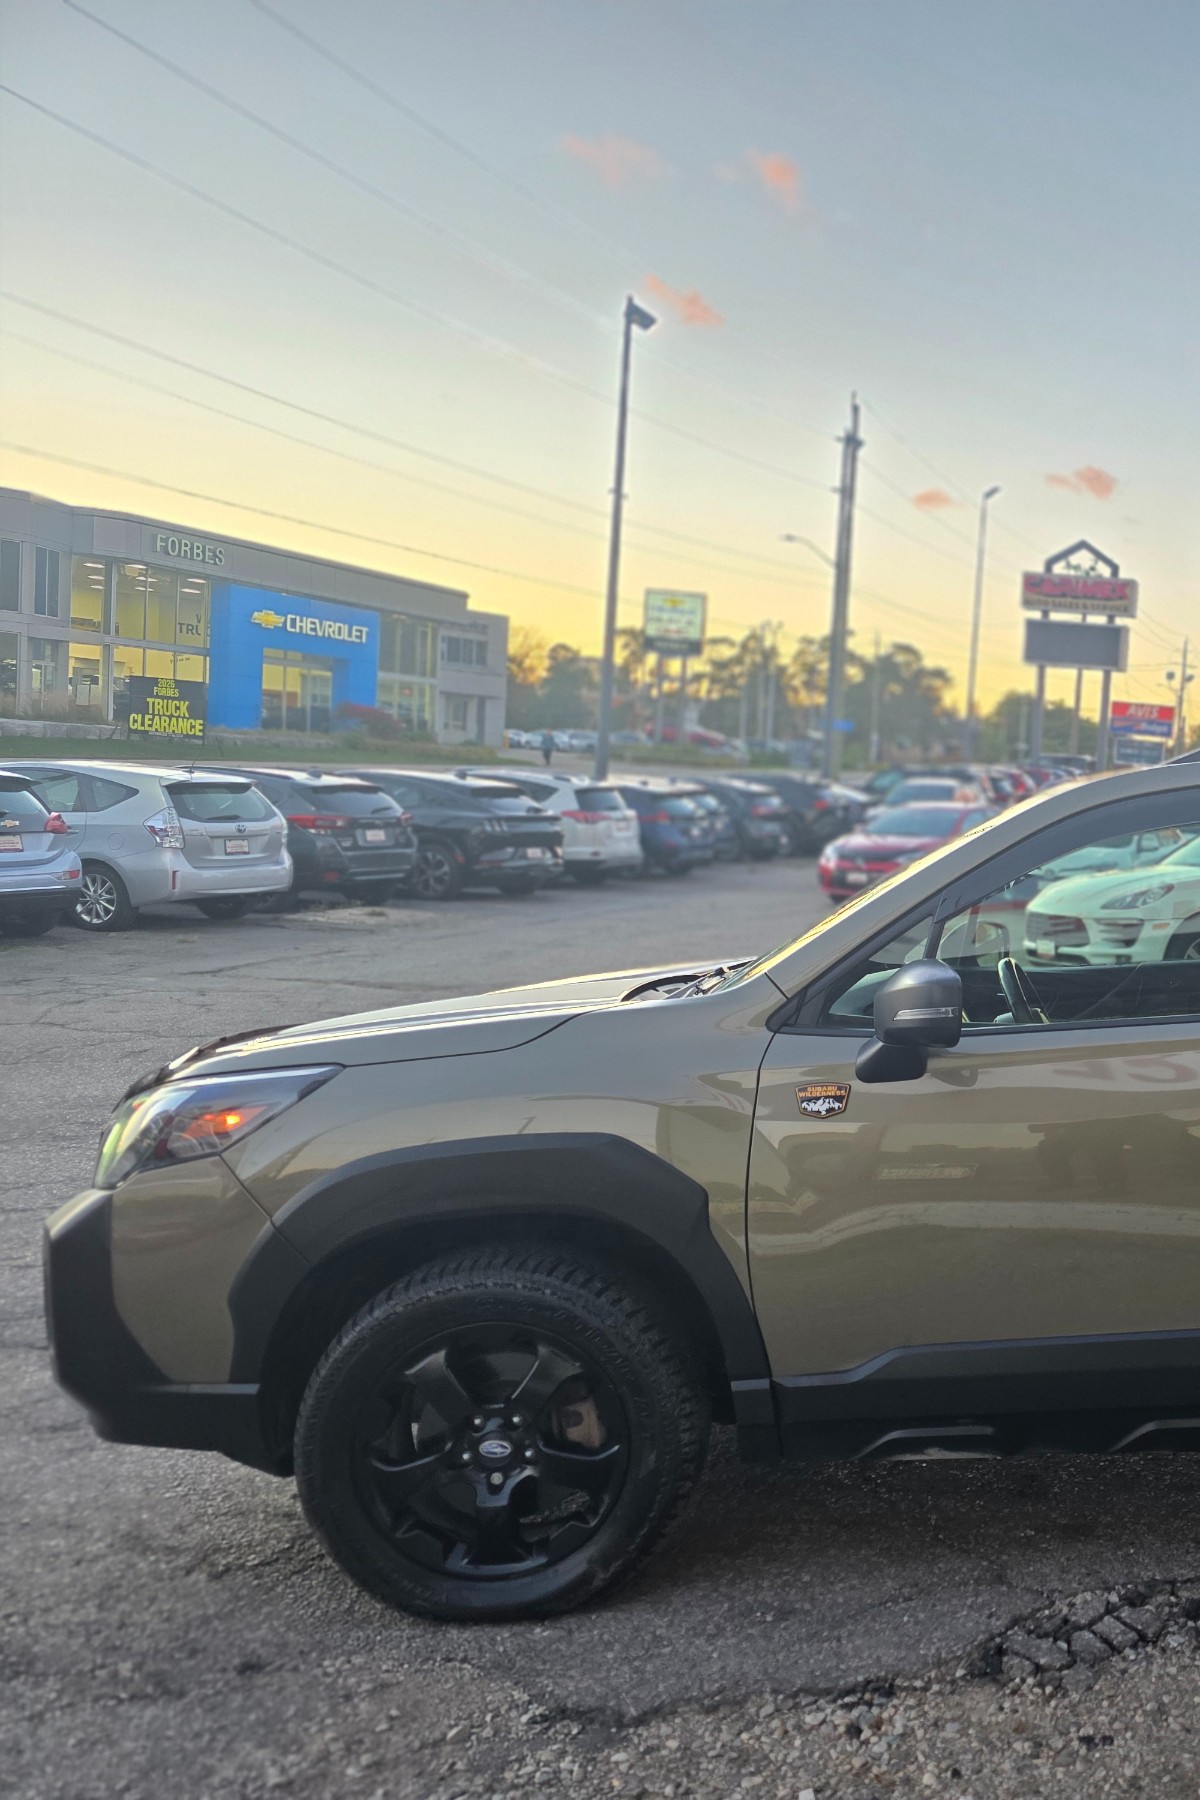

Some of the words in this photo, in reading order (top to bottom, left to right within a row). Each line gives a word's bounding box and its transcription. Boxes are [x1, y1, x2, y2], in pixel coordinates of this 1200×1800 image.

[156, 534, 225, 565] FORBES
[286, 614, 369, 644] CHEVROLET
[153, 687, 180, 698] FORBES
[158, 679, 176, 689] 2026
[147, 698, 190, 718] TRUCK
[1125, 704, 1161, 720] AVIS
[129, 713, 204, 737] CLEARANCE
